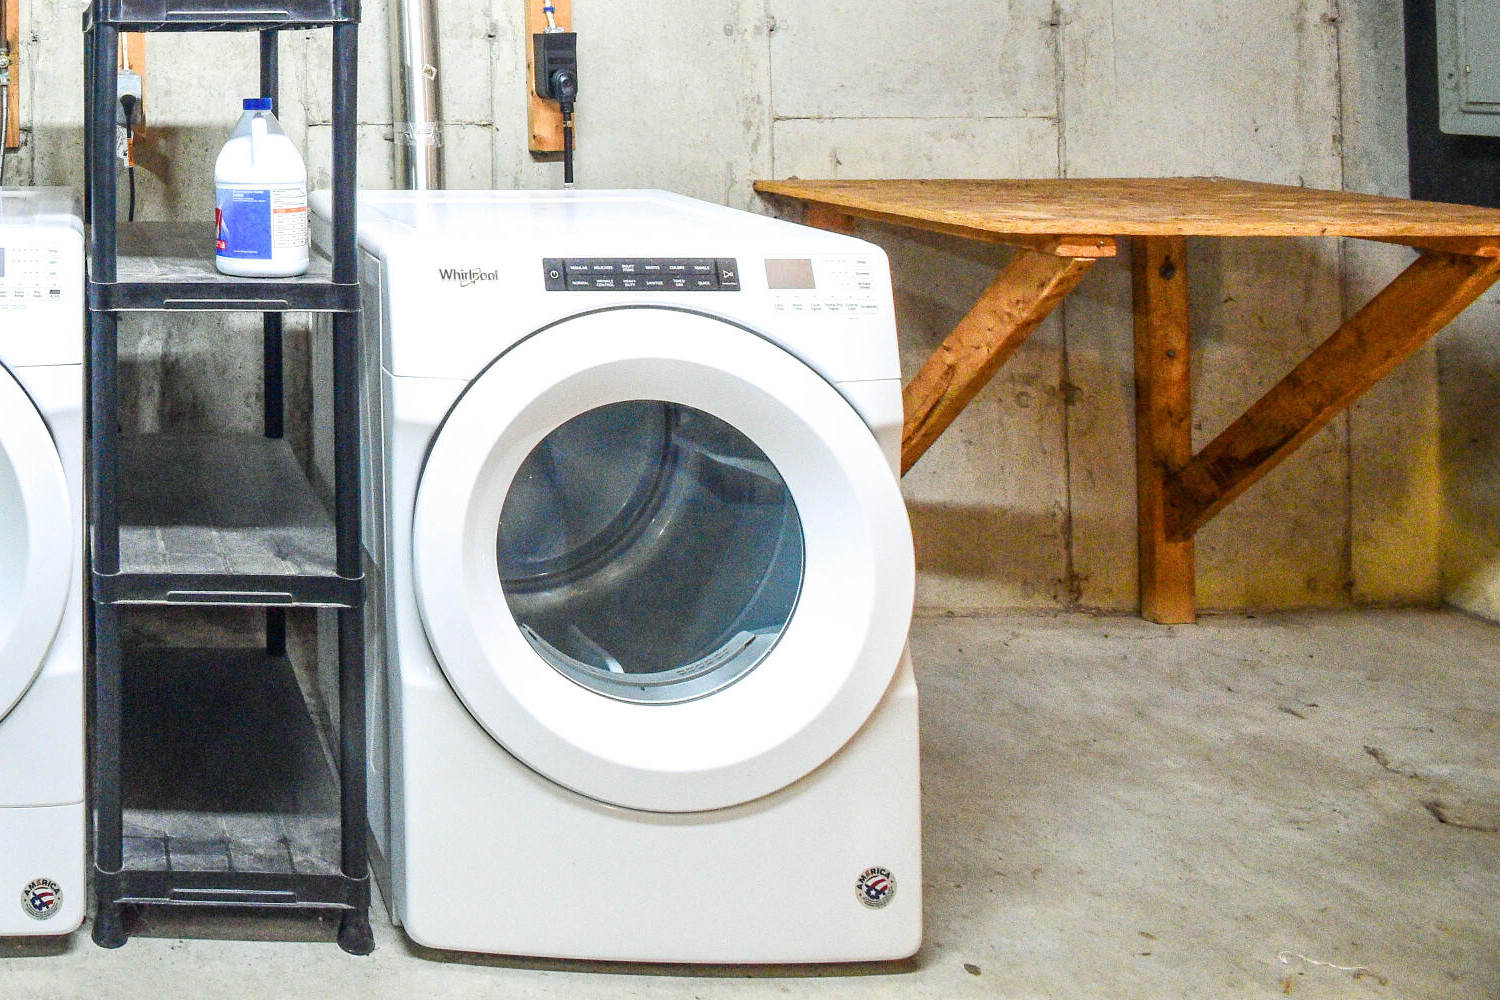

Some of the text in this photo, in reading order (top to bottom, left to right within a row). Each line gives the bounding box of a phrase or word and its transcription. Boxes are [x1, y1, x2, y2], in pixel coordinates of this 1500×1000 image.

[438, 267, 499, 285] Whirlpool
[24, 879, 60, 896] AMERICA
[856, 868, 891, 890] AMERICA
